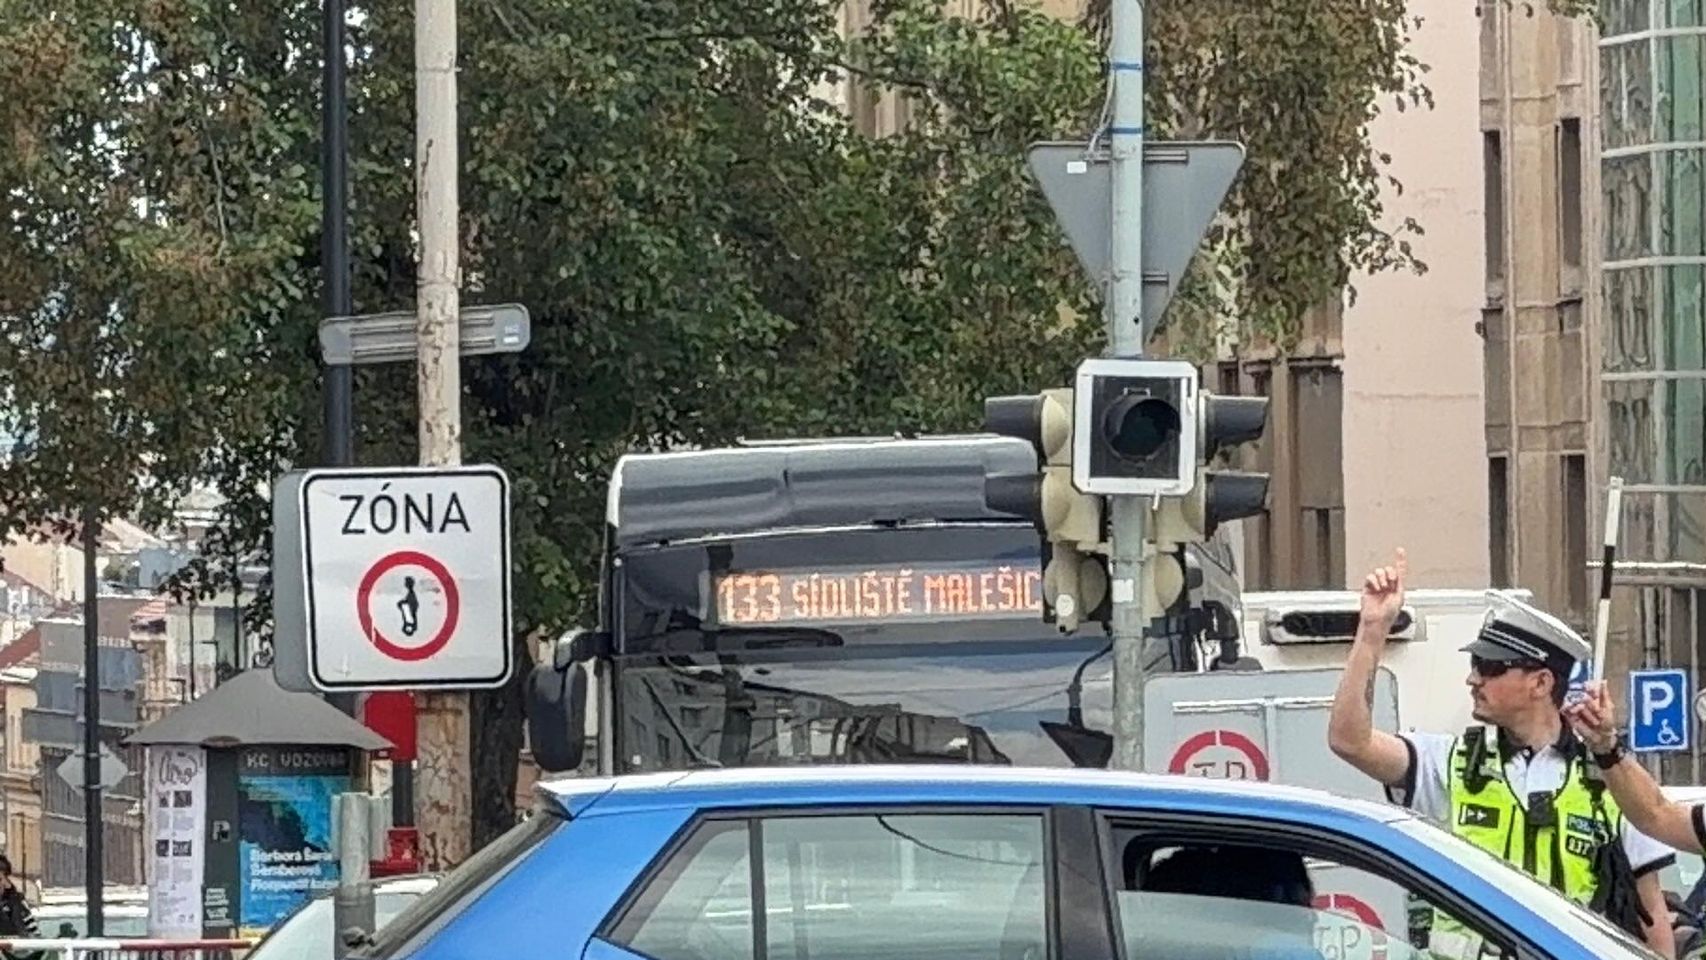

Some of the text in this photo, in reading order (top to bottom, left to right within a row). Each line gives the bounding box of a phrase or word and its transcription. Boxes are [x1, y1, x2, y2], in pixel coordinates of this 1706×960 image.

[338, 481, 471, 535] ZÓNA
[718, 565, 1041, 623] 133 SÍDLIŠTĚ MALEŠIC
[1642, 680, 1675, 727] P
